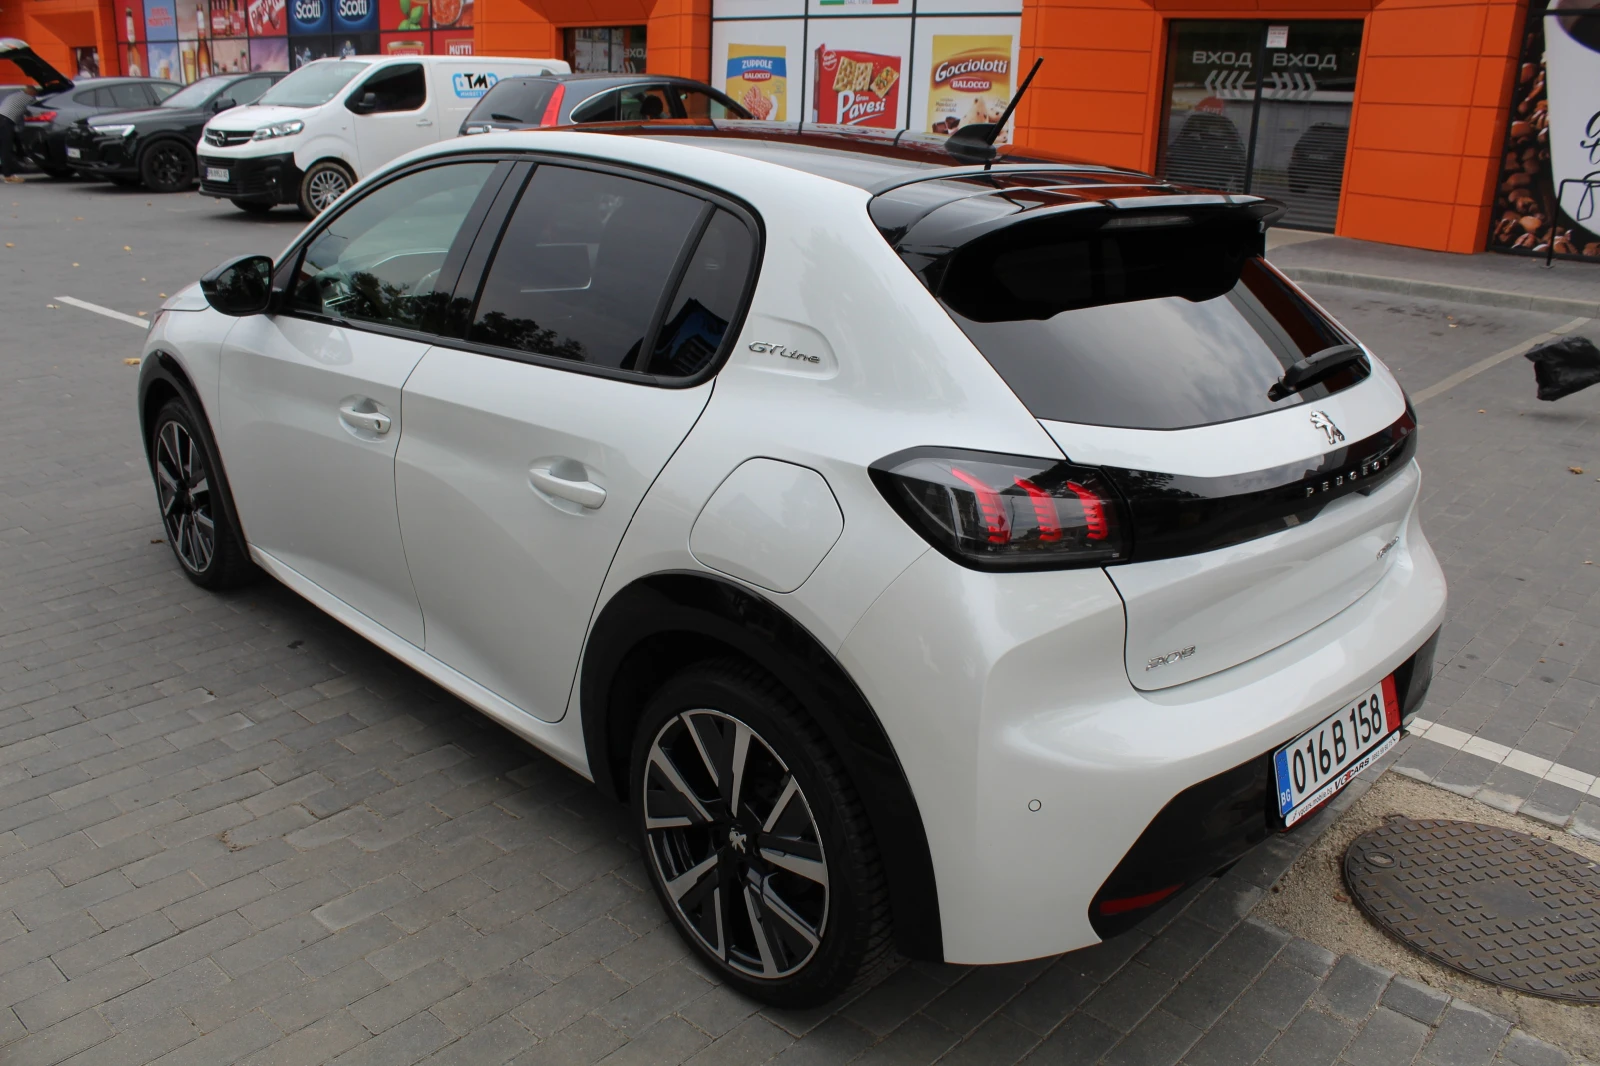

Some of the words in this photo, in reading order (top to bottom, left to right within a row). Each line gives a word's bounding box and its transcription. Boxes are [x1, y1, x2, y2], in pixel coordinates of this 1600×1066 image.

[295, 0, 321, 20] Scotti
[339, 0, 368, 17] Scotti
[449, 44, 472, 55] MUTTI
[623, 48, 646, 60] ВХО
[741, 59, 773, 70] ZUPPOLE
[1192, 50, 1252, 69] ВХОД
[1272, 52, 1337, 71] ВХОД
[744, 72, 771, 80] BALOCCO
[935, 58, 1008, 82] Gocciolotti
[952, 80, 990, 89] BALOCCO
[836, 89, 886, 125] Pavesi
[1306, 456, 1390, 498] PEUGEOT
[1292, 729, 1331, 794] 016
[1331, 719, 1347, 766] B
[1349, 693, 1382, 750] 158
[1280, 788, 1291, 806] BG
